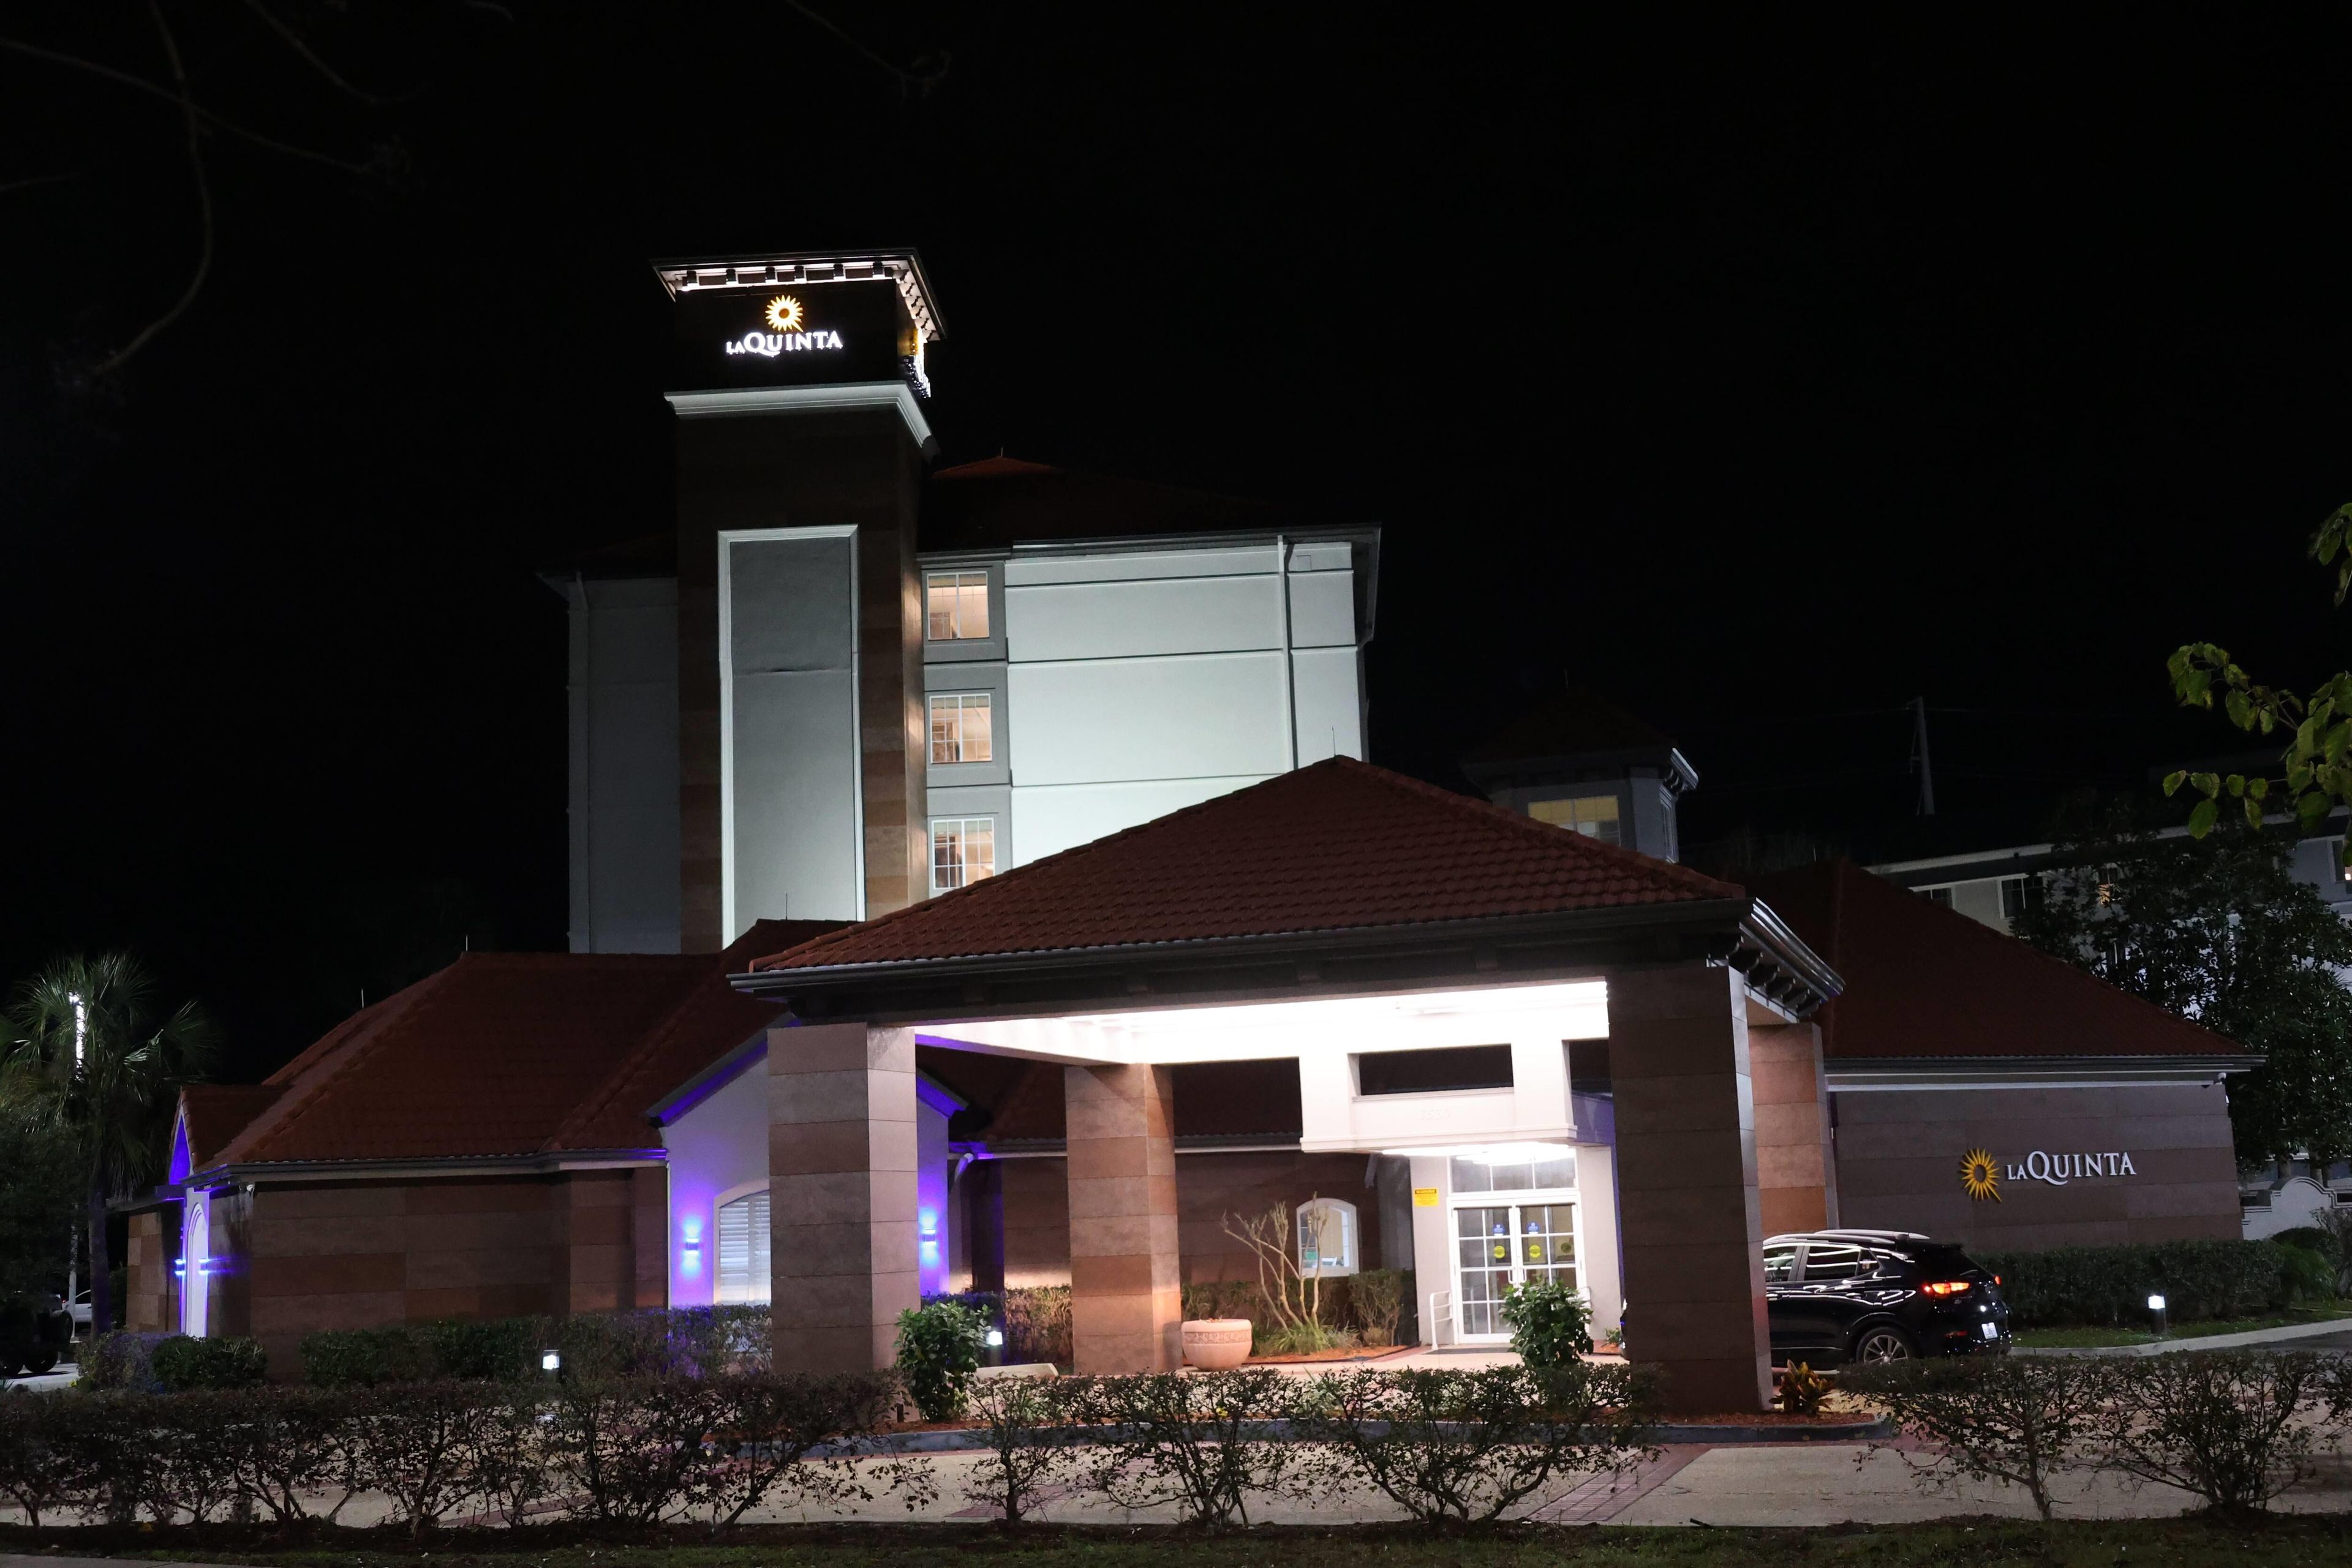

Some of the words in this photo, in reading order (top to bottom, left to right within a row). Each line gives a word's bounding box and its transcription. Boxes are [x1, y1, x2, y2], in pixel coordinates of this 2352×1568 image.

[726, 341, 745, 355] LA
[743, 331, 843, 357] QUINTA
[2007, 1164, 2027, 1180] LA
[2027, 1151, 2137, 1185] QUINTA
